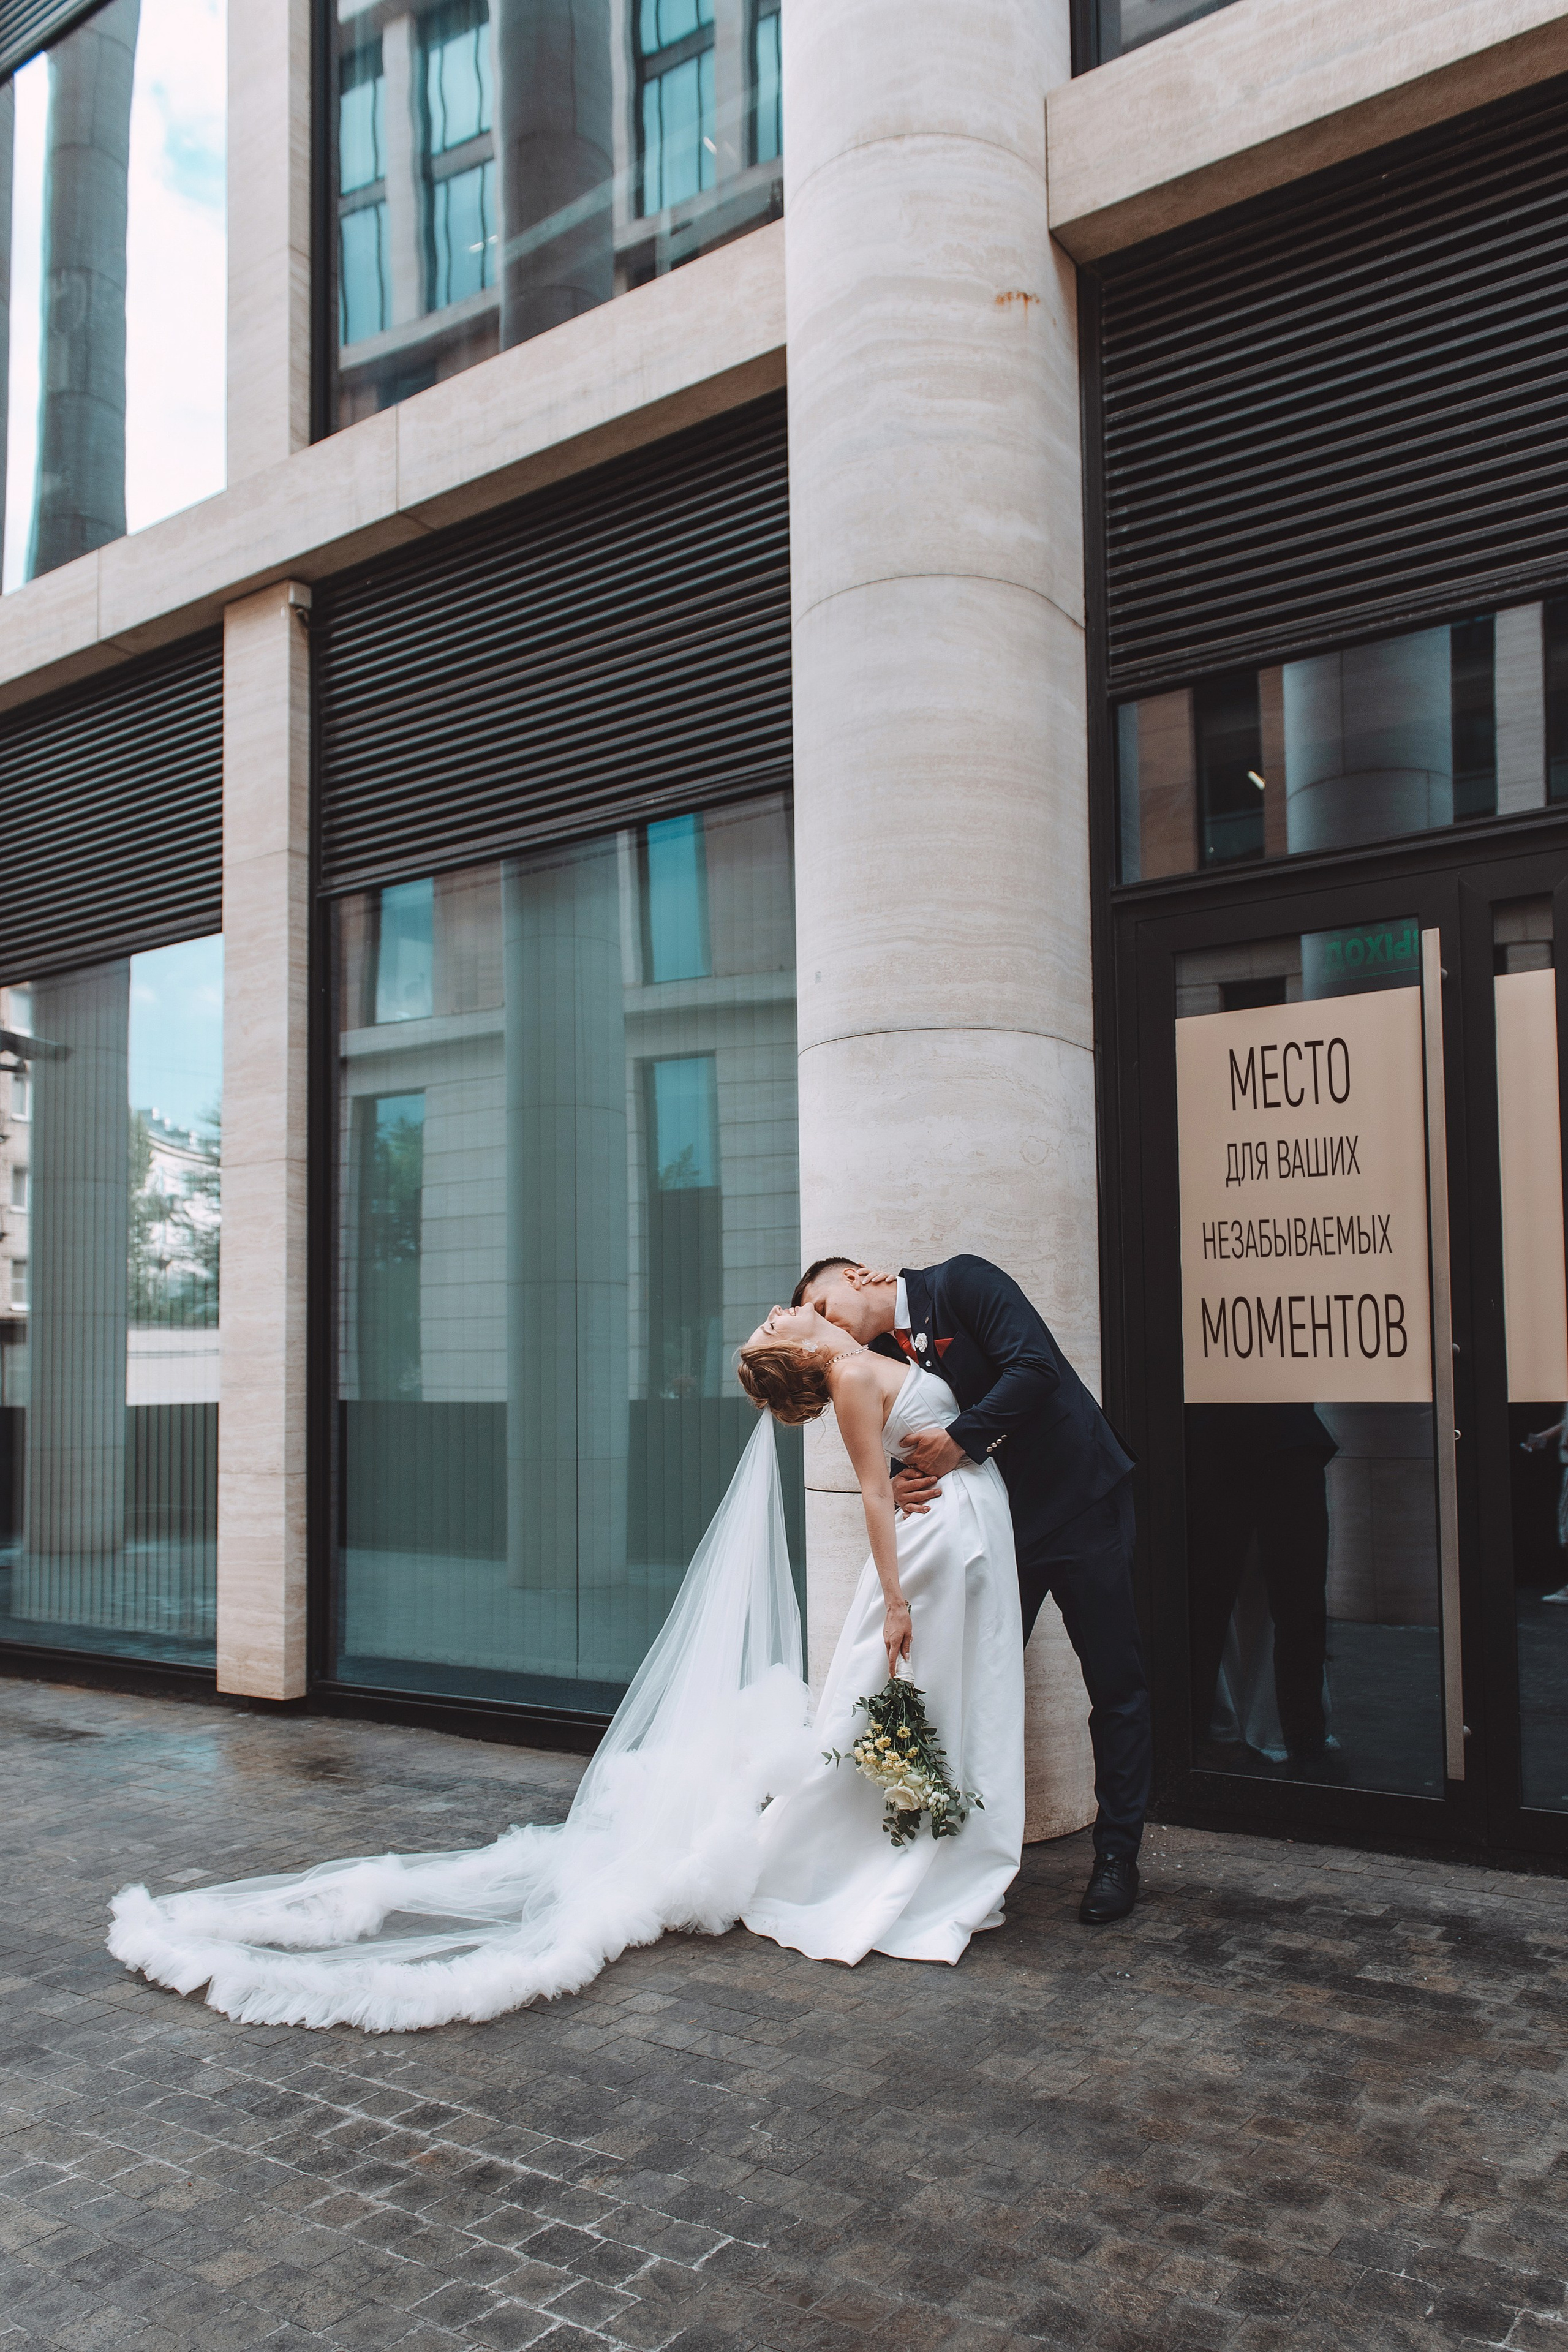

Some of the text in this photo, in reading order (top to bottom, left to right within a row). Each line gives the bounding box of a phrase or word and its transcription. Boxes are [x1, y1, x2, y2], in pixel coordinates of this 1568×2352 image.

[1229, 1037, 1351, 1111] МЕСТО
[1226, 1135, 1361, 1188] ДЛЯ ВАШИХ
[1202, 1213, 1393, 1260] НЕЗАБЫВАЕМЫХ
[1200, 1293, 1408, 1359] МОМЕНТОВ
